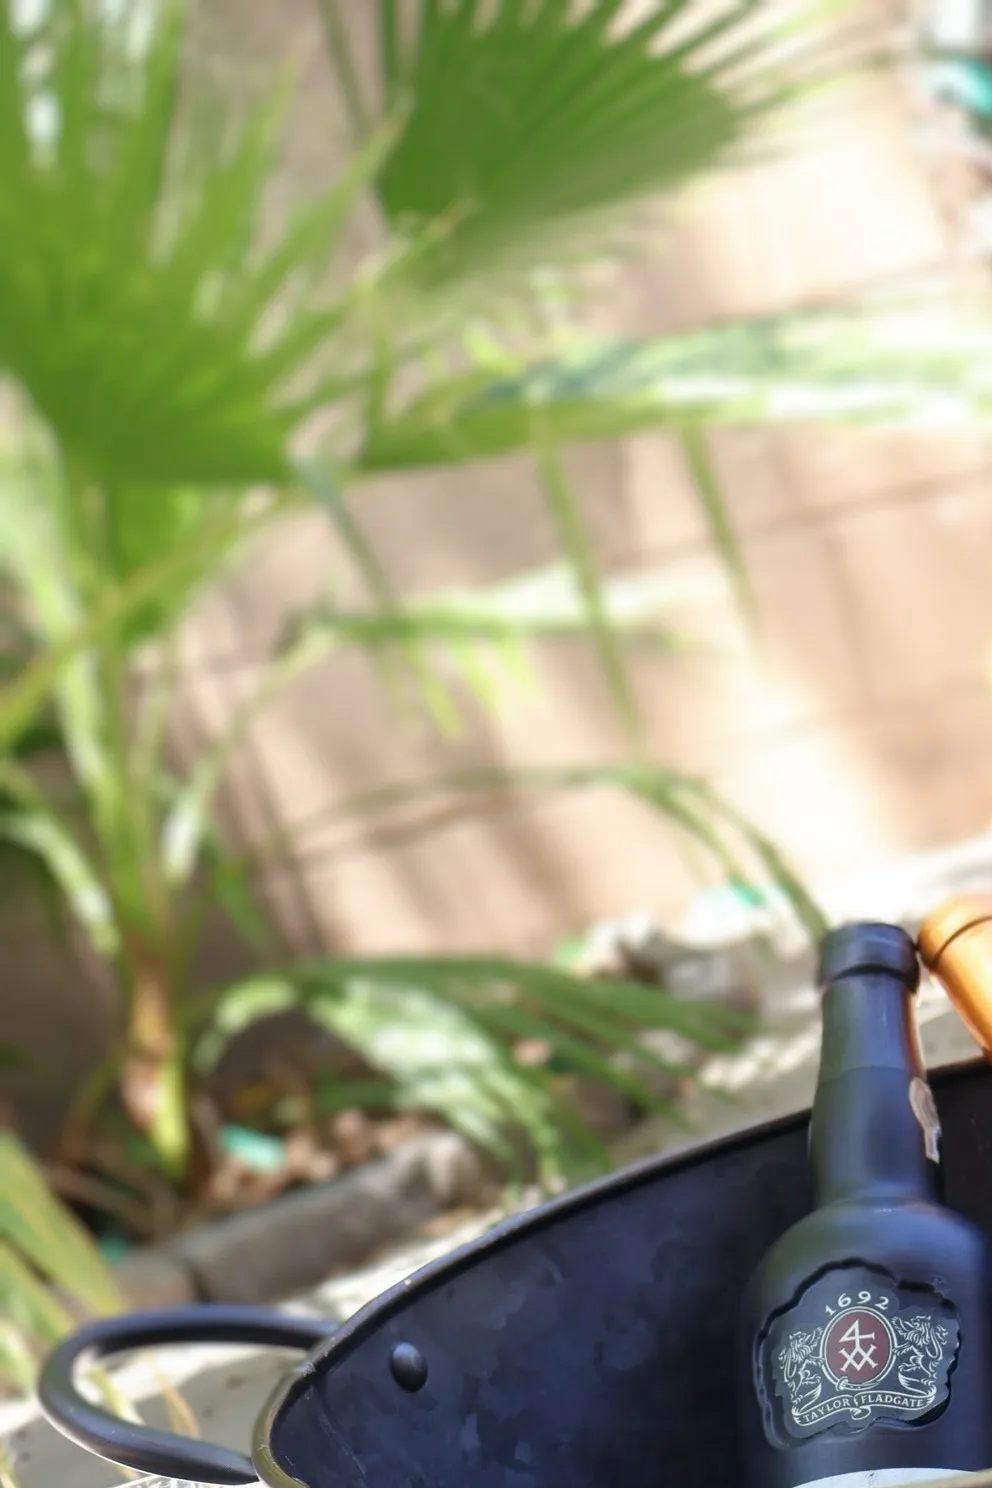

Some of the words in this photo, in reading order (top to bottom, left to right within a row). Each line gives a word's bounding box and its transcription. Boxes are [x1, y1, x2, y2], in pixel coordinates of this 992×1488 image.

[824, 1290, 890, 1317] 1692
[802, 1398, 851, 1424] TAYLOR
[860, 1393, 924, 1409] FLADGATE
